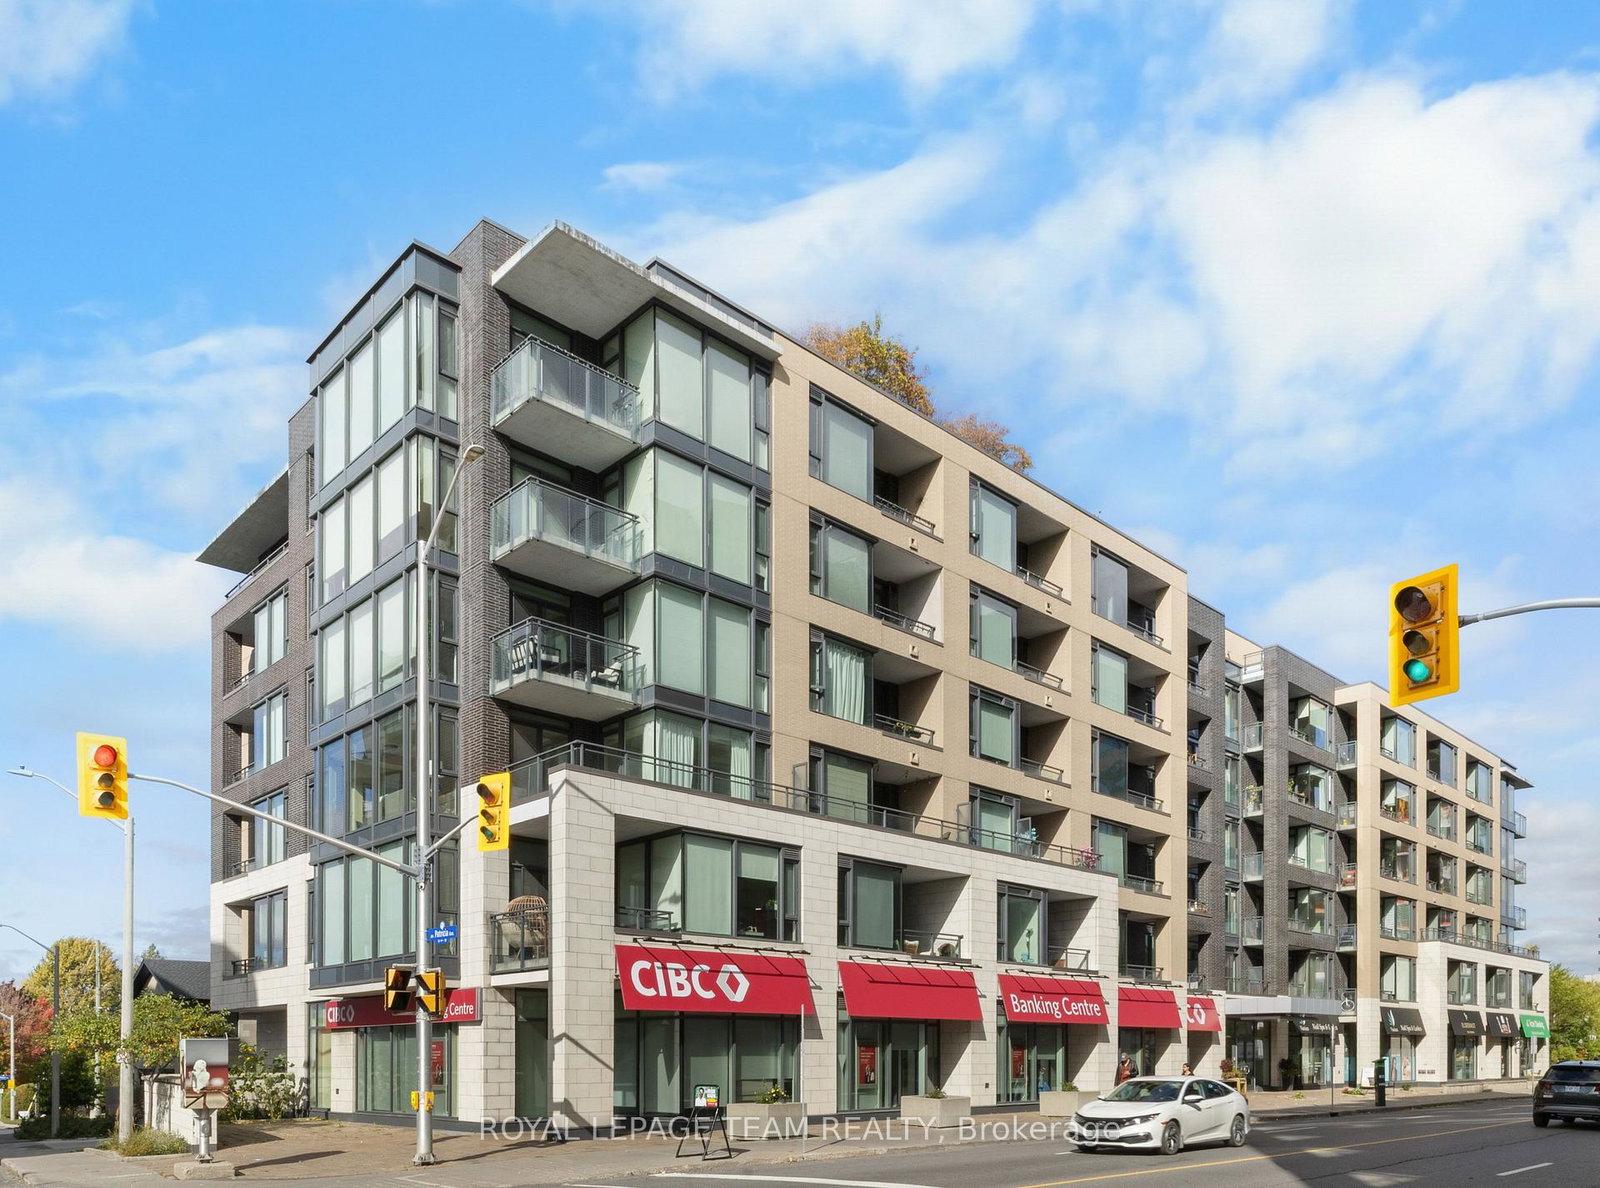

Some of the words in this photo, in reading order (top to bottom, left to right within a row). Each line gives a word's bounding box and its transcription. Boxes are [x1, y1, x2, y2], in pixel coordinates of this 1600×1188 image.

[630, 960, 716, 999] CIBC
[327, 1006, 346, 1023] CIBC
[449, 1002, 474, 1016] Centre
[1010, 994, 1061, 1019] Banking
[1062, 997, 1102, 1017] Centre
